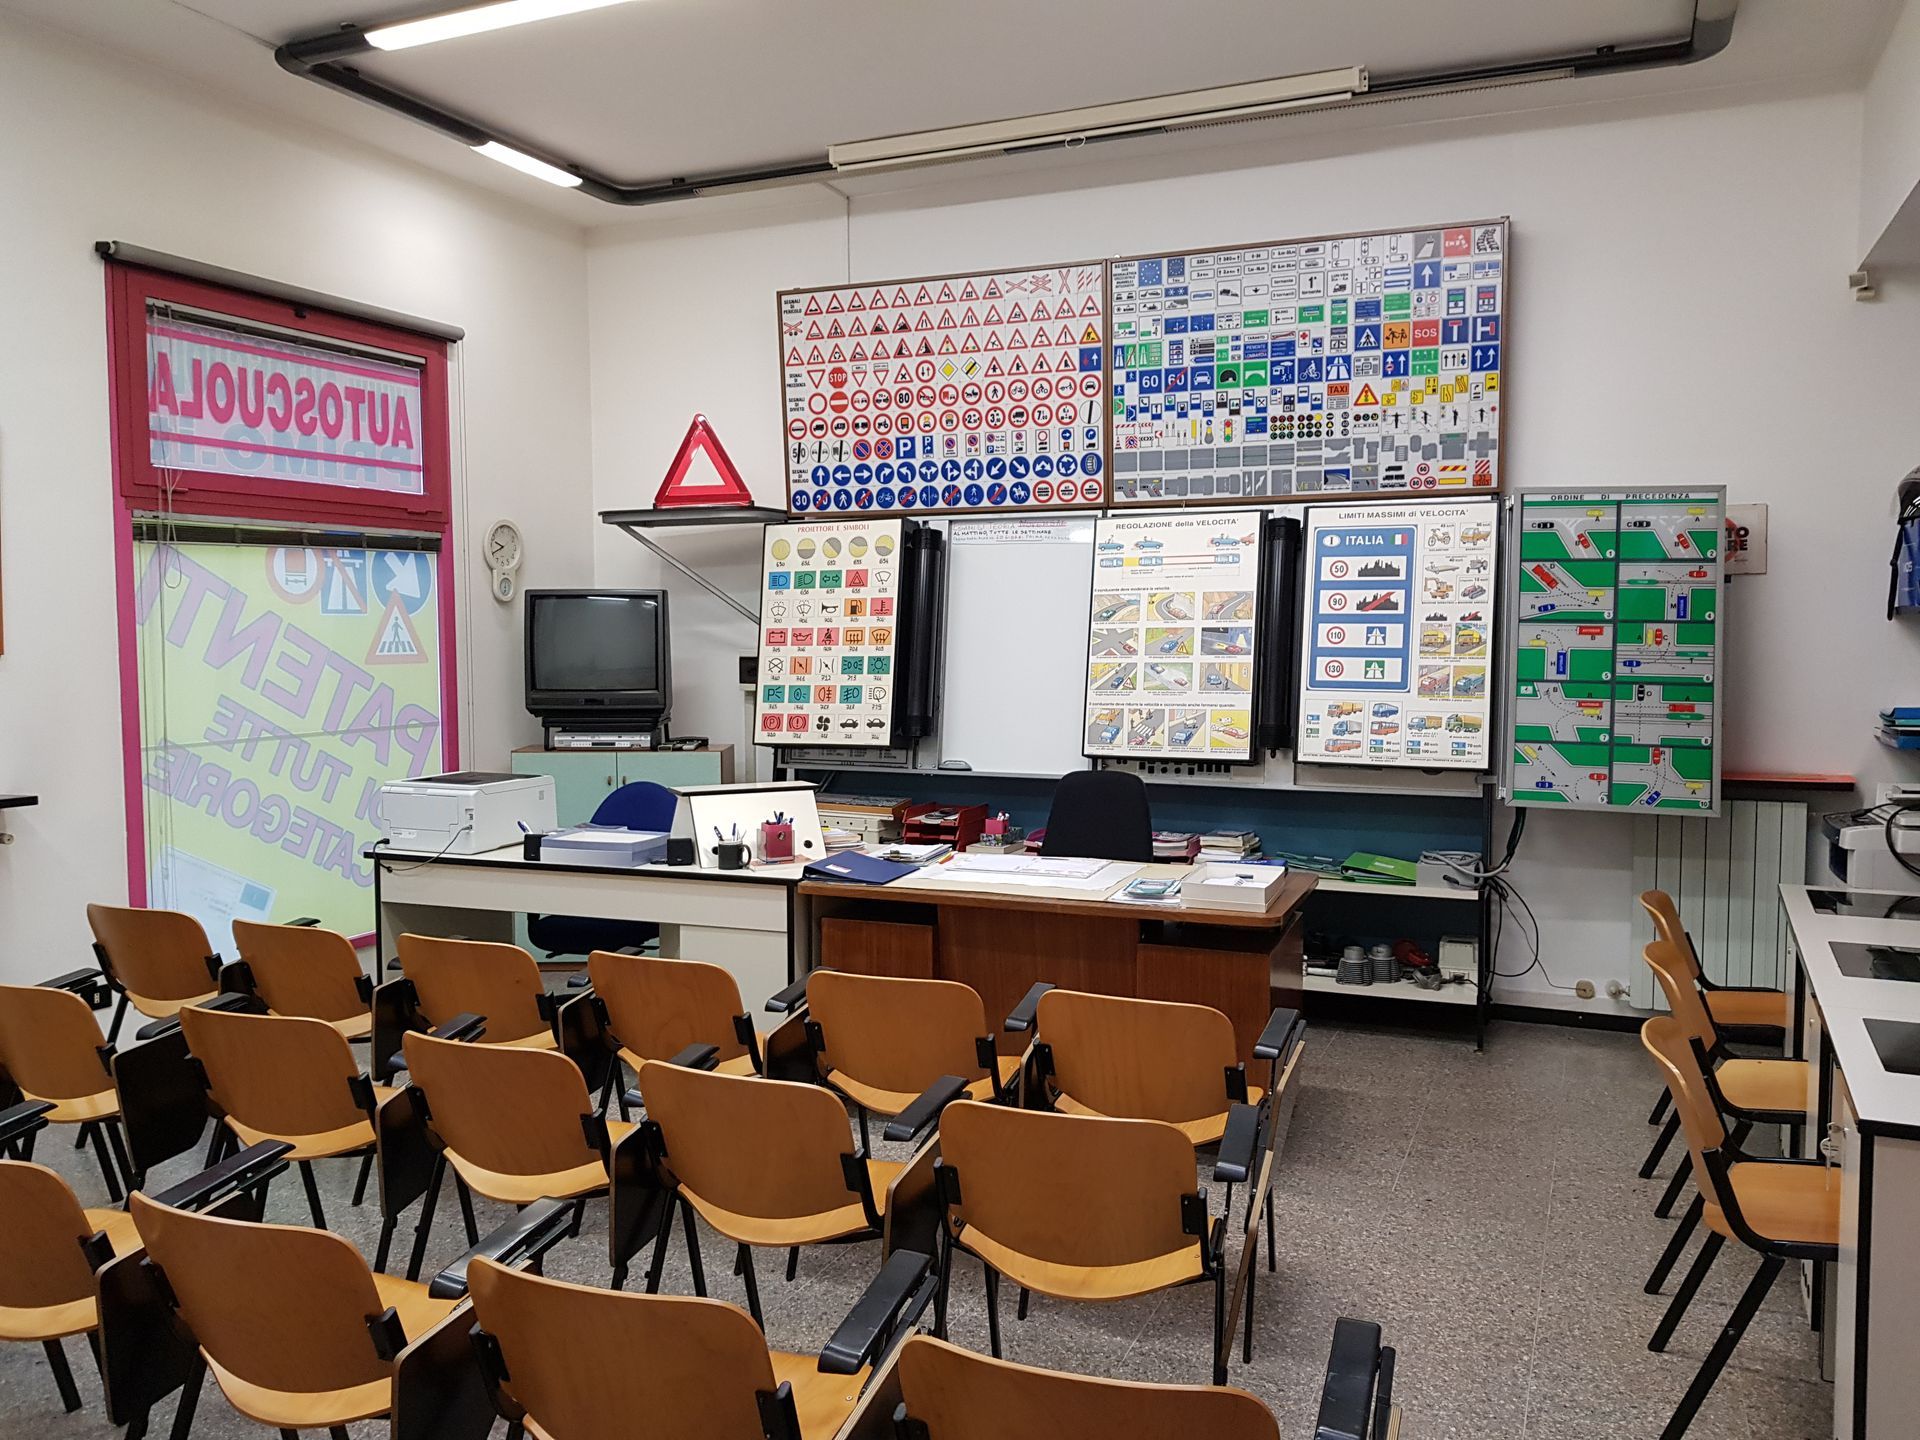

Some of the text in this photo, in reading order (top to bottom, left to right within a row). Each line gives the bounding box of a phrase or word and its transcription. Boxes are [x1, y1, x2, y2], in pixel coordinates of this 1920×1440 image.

[1415, 328, 1437, 338] SOS
[829, 373, 847, 383] STOP
[1143, 375, 1158, 387] 60
[1168, 374, 1184, 386] 60
[1329, 384, 1348, 392] TAXI
[898, 393, 910, 403] 80
[924, 437, 931, 446] P
[900, 438, 911, 457] P
[795, 496, 806, 505] 30
[1338, 512, 1365, 520] LIMITI
[797, 524, 834, 533] PROIETTORI
[1116, 521, 1172, 530] REGOLAZIONE
[1329, 535, 1384, 545] I ITALIA
[1333, 565, 1345, 573] 50
[1332, 598, 1343, 606] 90
[1330, 632, 1342, 640] 110
[1328, 665, 1341, 673] 130
